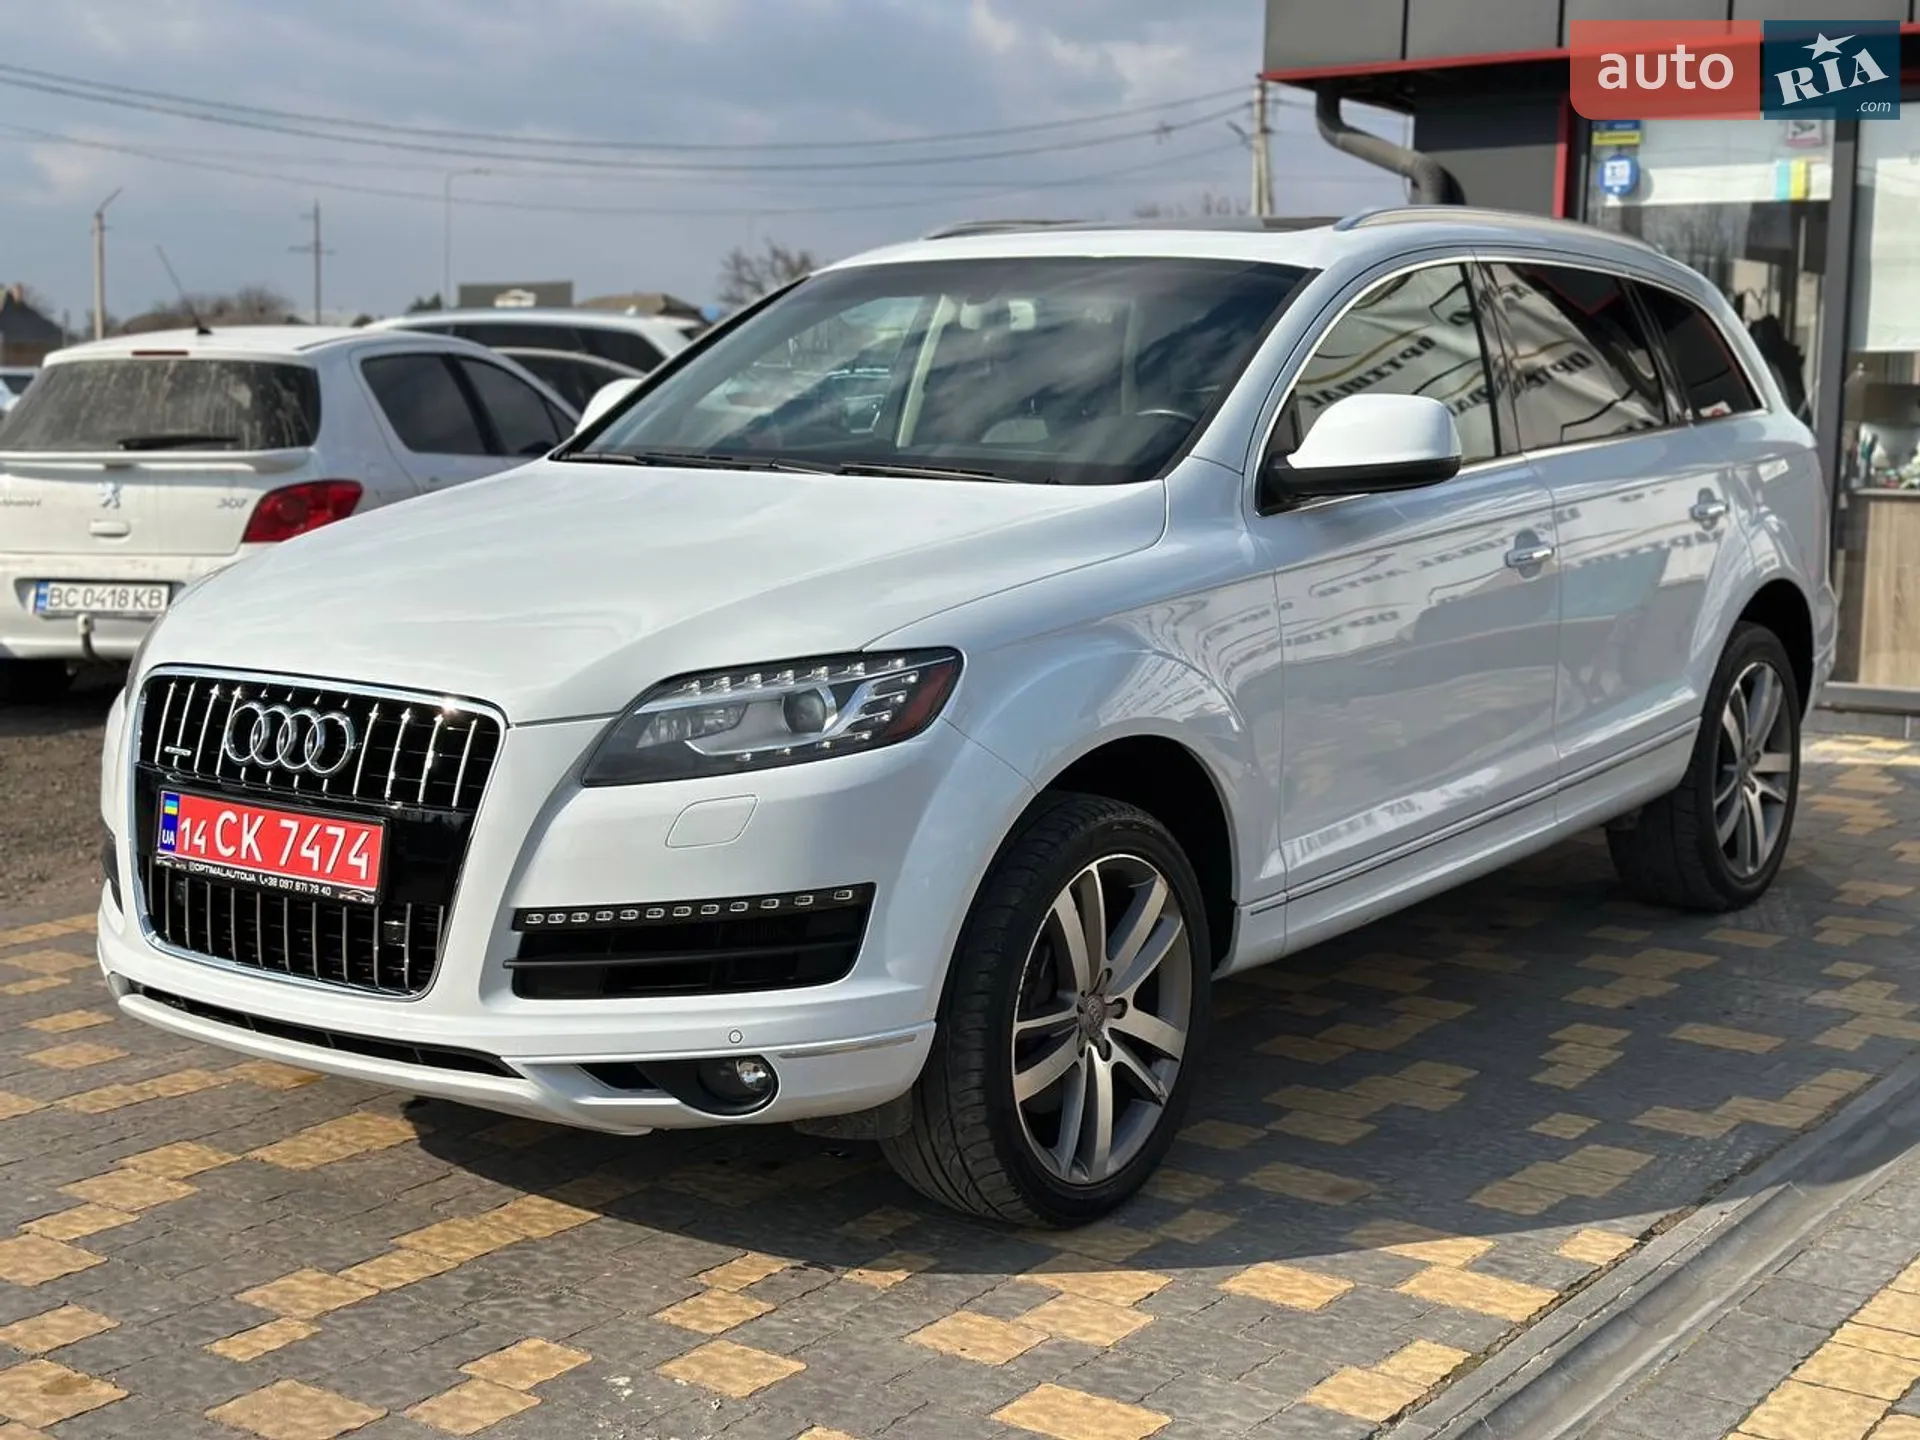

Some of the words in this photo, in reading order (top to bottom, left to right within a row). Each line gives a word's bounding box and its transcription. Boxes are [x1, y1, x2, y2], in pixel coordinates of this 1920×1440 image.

[50, 586, 79, 608] BC
[83, 587, 130, 609] 0418
[133, 588, 163, 609] KB
[161, 829, 176, 846] UA
[180, 817, 207, 855] 14
[214, 810, 265, 863] CK
[279, 818, 370, 881] 7474
[321, 886, 332, 897] 40
